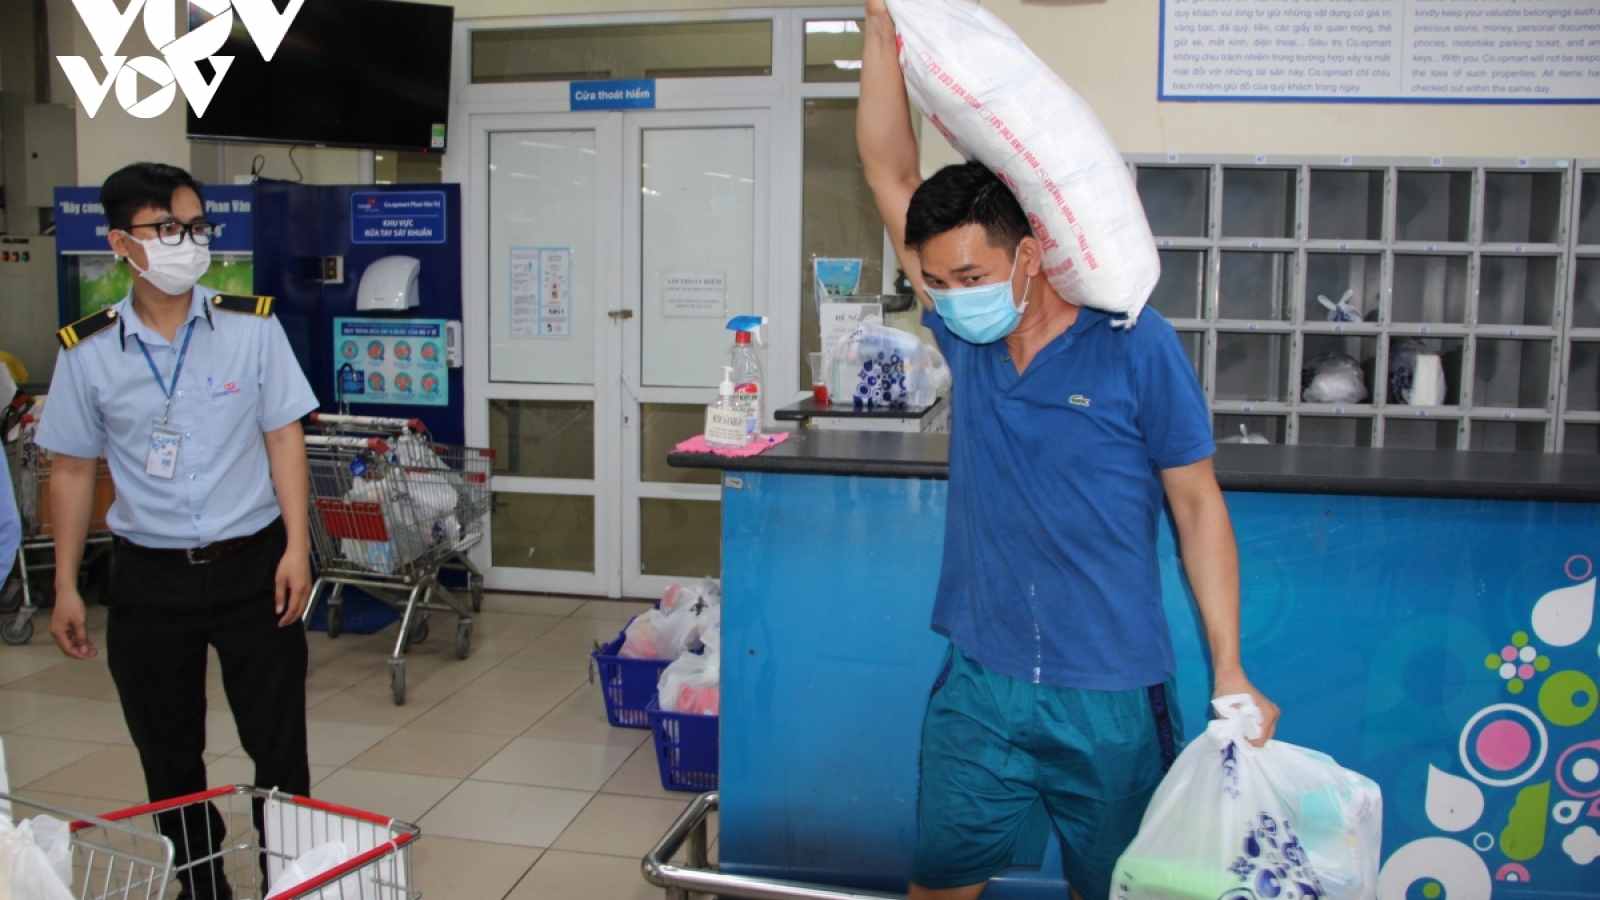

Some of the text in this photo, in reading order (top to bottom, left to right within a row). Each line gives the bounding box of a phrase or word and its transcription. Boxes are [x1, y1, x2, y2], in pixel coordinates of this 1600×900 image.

[1415, 9, 1440, 19] kindly
[1442, 9, 1463, 18] keep
[1464, 10, 1484, 19] your
[1485, 8, 1522, 17] valuable
[1523, 8, 1572, 19] belongings
[1574, 8, 1596, 16] such
[1326, 25, 1348, 34] quan
[1414, 24, 1451, 33] precious
[1517, 24, 1556, 33] personal
[1558, 24, 1600, 32] document
[1346, 38, 1391, 48] Co.opmart
[1452, 39, 1495, 48] motorbike
[1499, 39, 1532, 49] parking
[1566, 38, 1584, 47] and
[1588, 40, 1600, 48] an
[1272, 54, 1294, 63] trong
[1441, 54, 1460, 62] With
[1482, 54, 1528, 64] Co.opmart
[1530, 54, 1544, 62] will
[1546, 54, 1560, 62] not
[1562, 54, 1574, 62] be
[1576, 55, 1600, 64] respo
[1308, 68, 1352, 78] Co.opmart
[1412, 69, 1426, 77] the
[1431, 69, 1448, 77] loss
[1453, 69, 1462, 78] of
[1466, 69, 1487, 78] such
[1542, 69, 1554, 78] All
[1558, 70, 1583, 78] items
[1588, 69, 1600, 78] ha
[1316, 84, 1338, 93] trong
[1412, 84, 1448, 92] checked
[1450, 84, 1464, 92] out
[1465, 84, 1490, 92] within
[1492, 84, 1506, 92] the
[575, 87, 650, 100] Cửa thoát hiểm
[205, 200, 229, 212] Phan
[383, 218, 413, 228] KHU VỰC
[394, 228, 406, 236] SÁT
